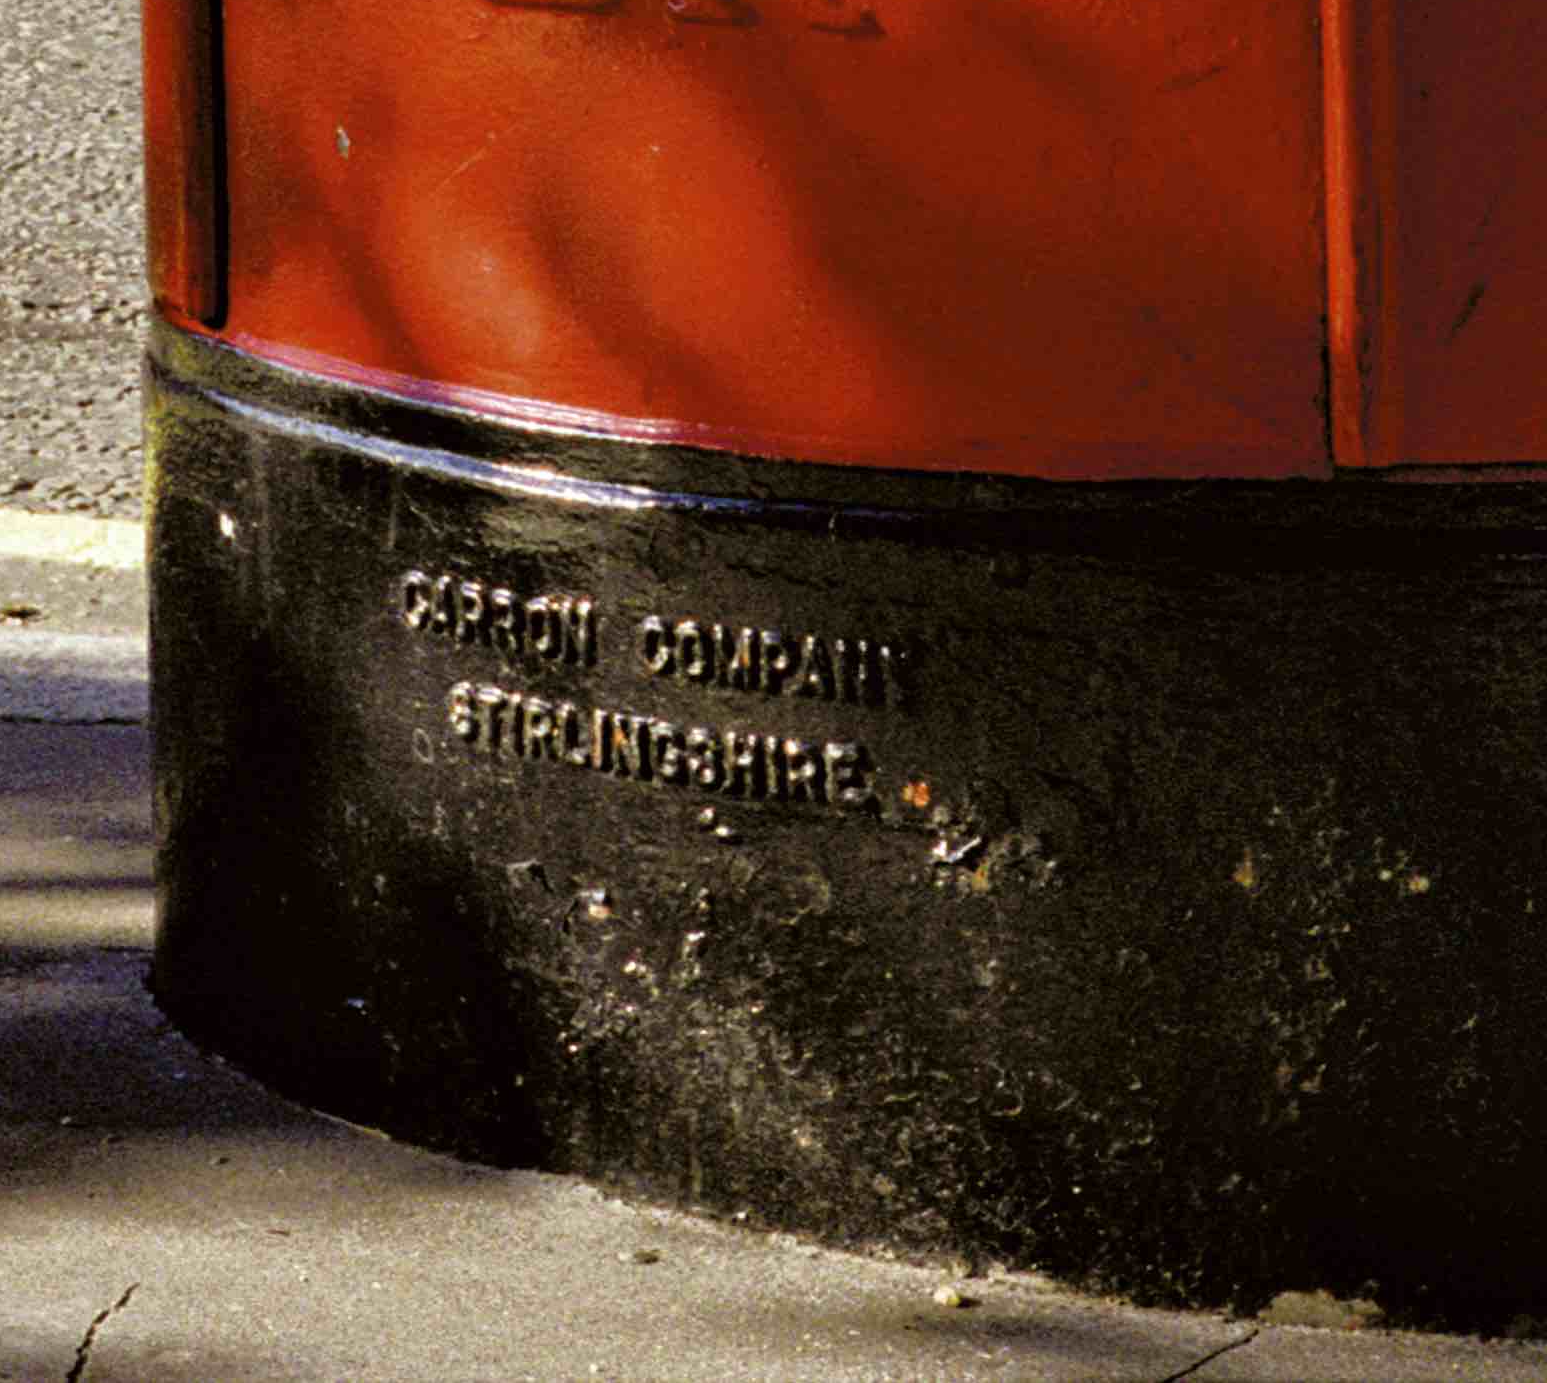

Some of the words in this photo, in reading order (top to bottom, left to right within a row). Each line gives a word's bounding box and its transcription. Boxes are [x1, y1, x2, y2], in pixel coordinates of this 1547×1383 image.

[403, 570, 599, 667] CARRON
[640, 615, 905, 706] COMPANY
[449, 681, 876, 805] STIRLINGSHIRE
